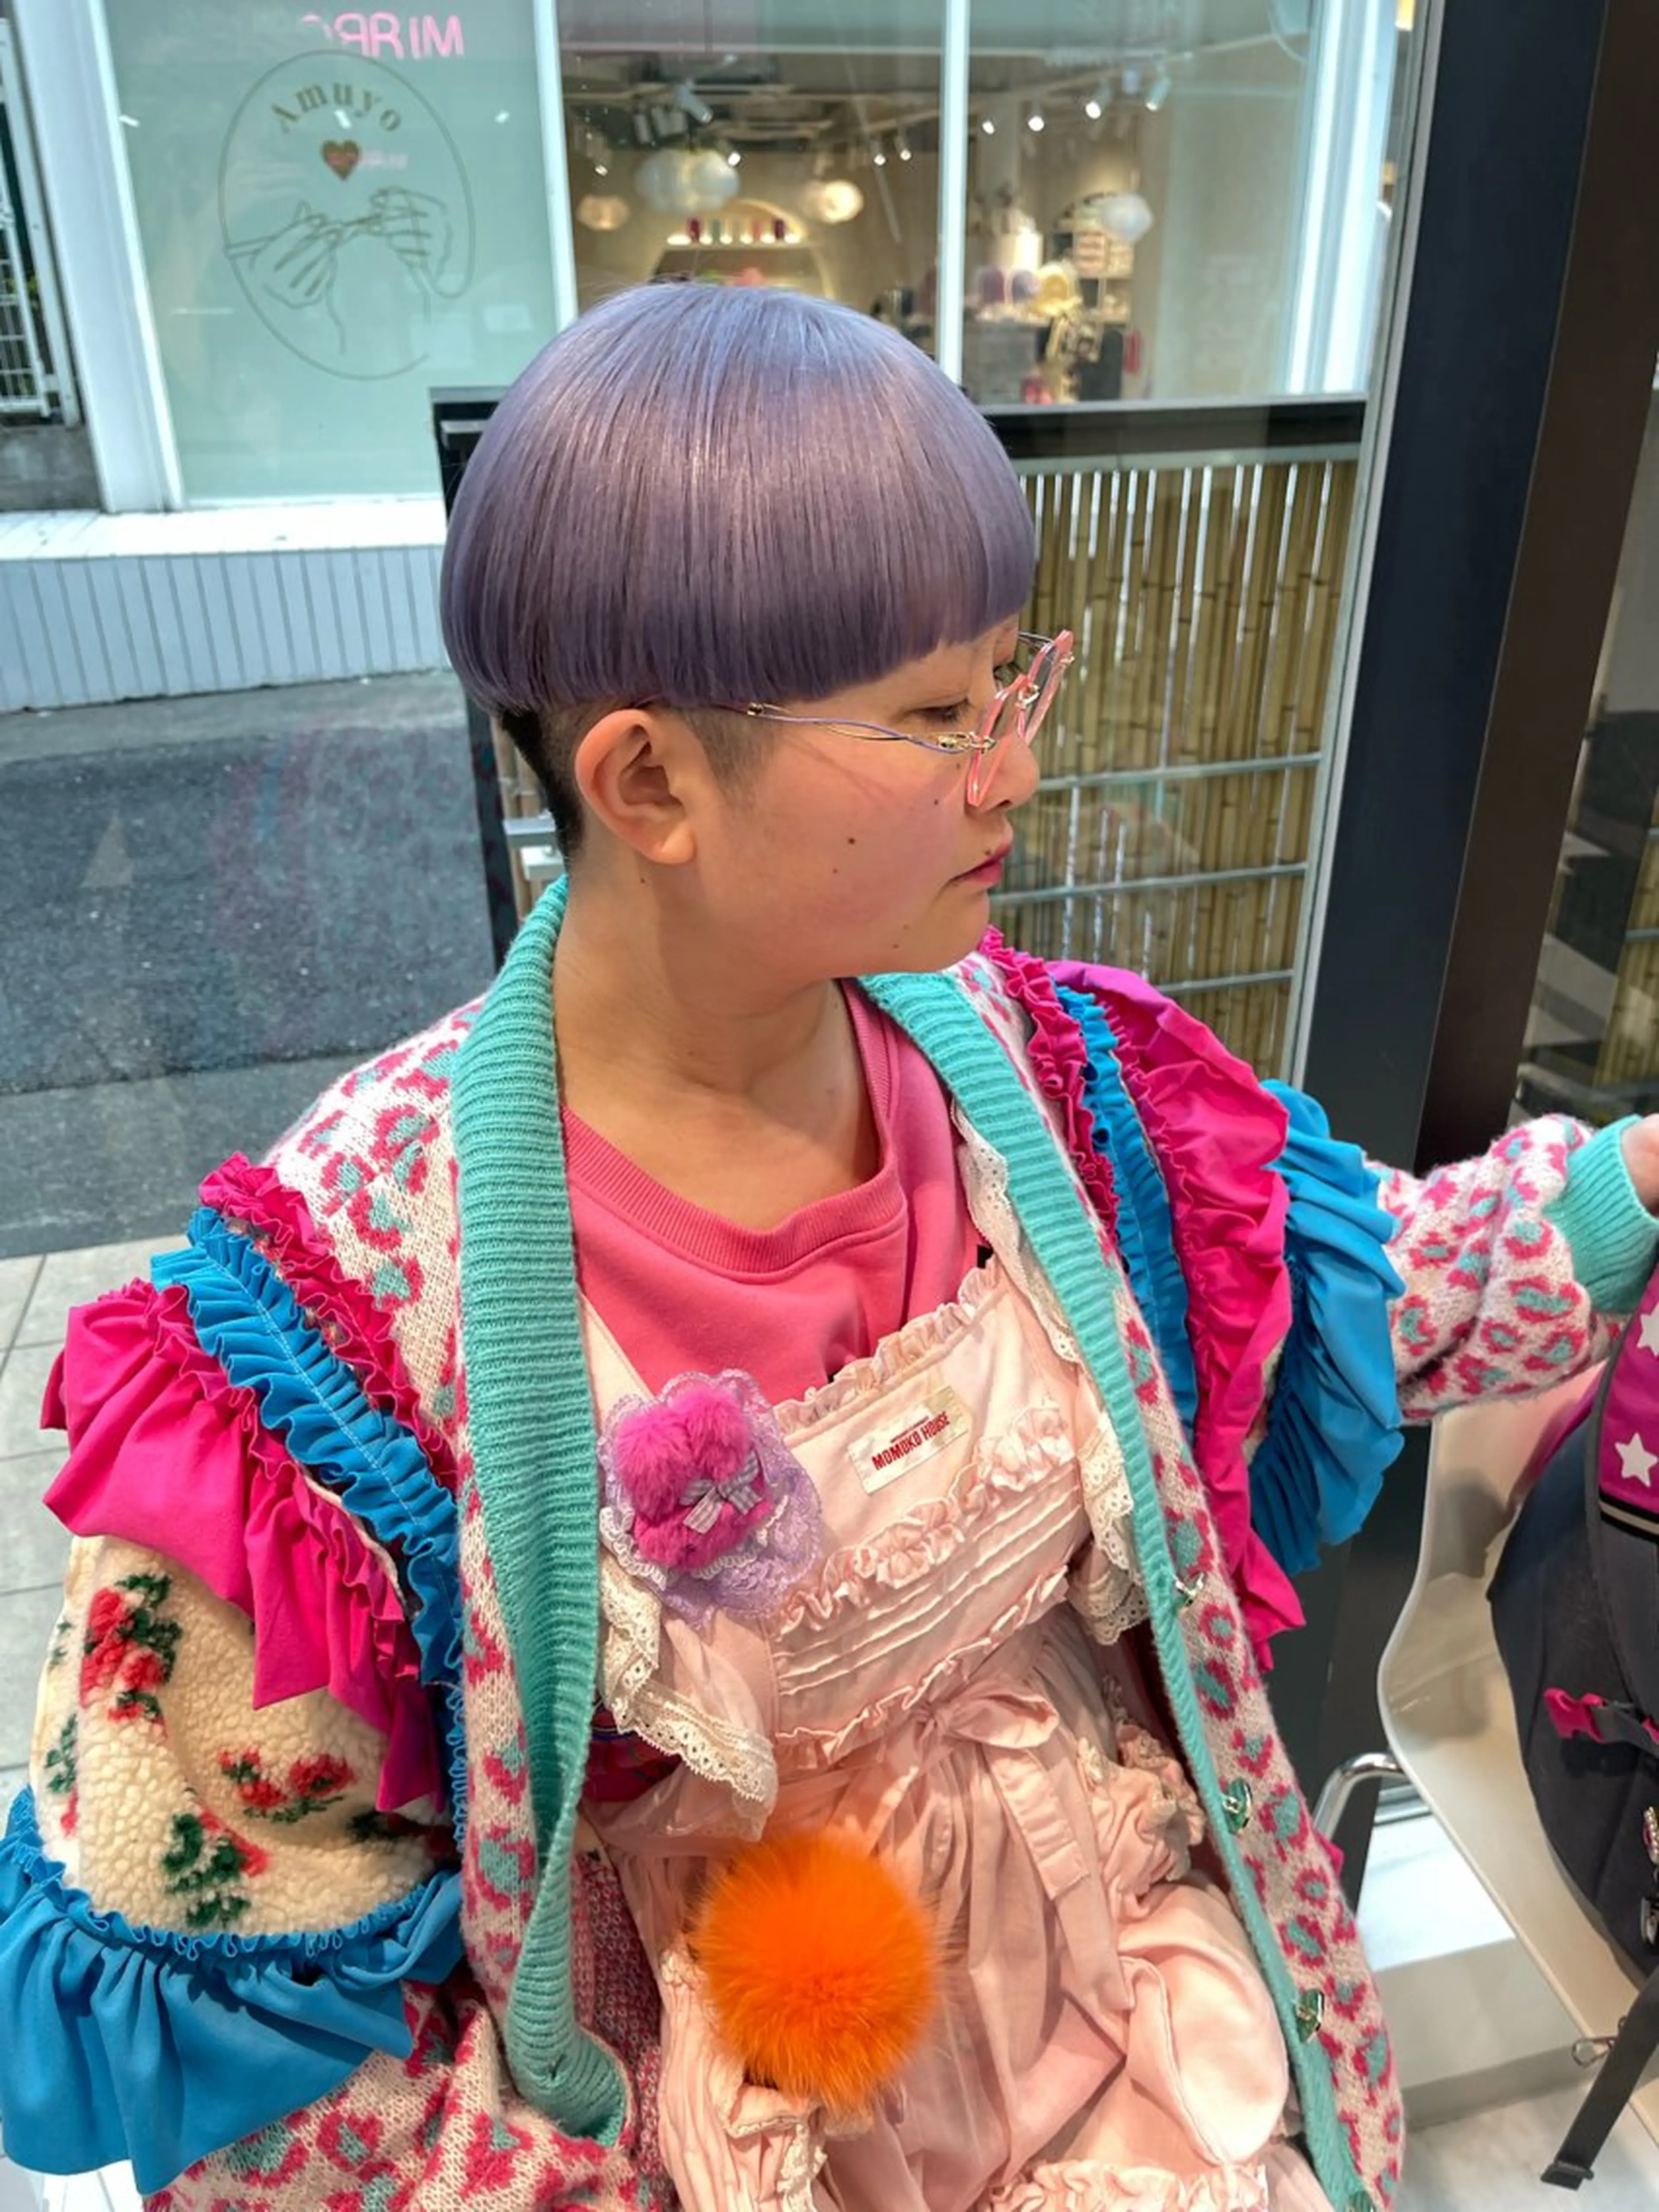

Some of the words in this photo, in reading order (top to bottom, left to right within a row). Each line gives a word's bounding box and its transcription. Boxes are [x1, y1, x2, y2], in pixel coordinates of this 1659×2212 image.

[271, 82, 401, 135] Amuyo
[871, 1431, 923, 1471] MOMOKO
[920, 1411, 950, 1443] HOUSE
